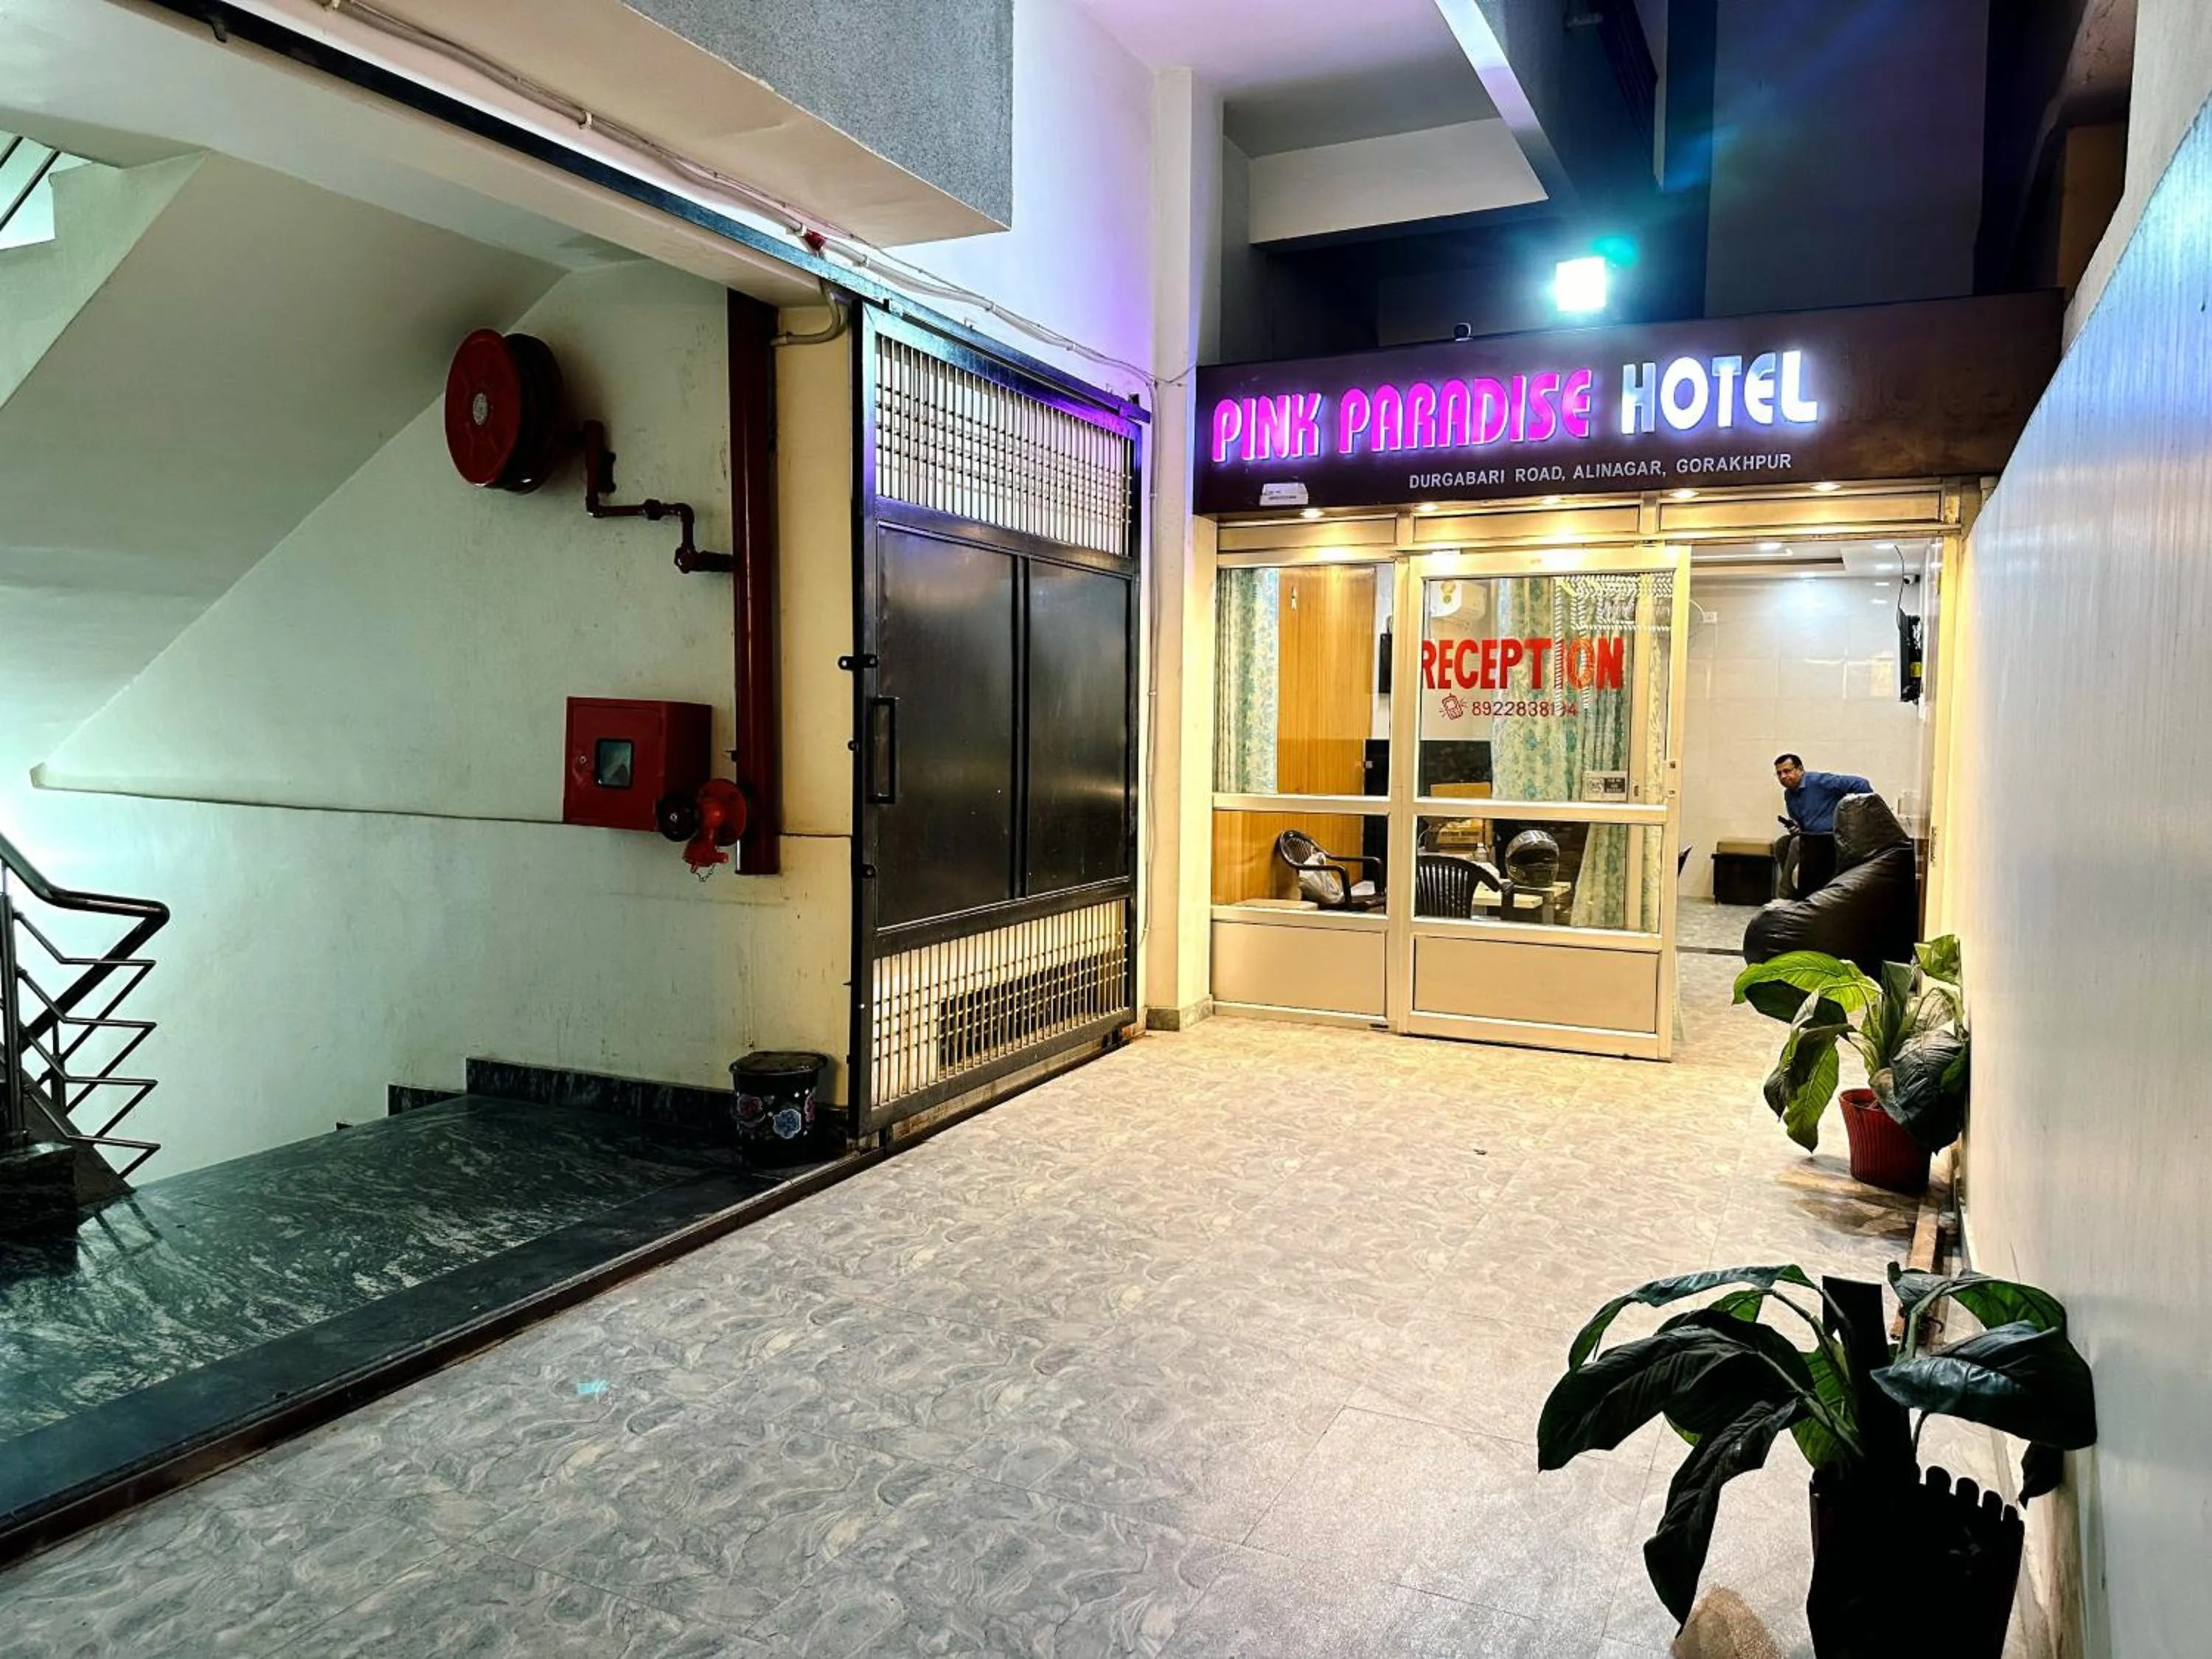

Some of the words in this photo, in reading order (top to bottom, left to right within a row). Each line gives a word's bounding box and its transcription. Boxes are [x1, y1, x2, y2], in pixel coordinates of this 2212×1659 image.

[1212, 394, 1321, 462] PINK
[1339, 369, 1593, 453] PARADISE
[1621, 349, 1818, 435] HOTEL
[1409, 470, 1505, 489] DURGABARI
[1515, 467, 1566, 482] ROAD,
[1573, 461, 1667, 479] ALINAGAR,
[1676, 453, 1792, 473] GORAKHPUR
[1422, 637, 1624, 689] RECEPTION
